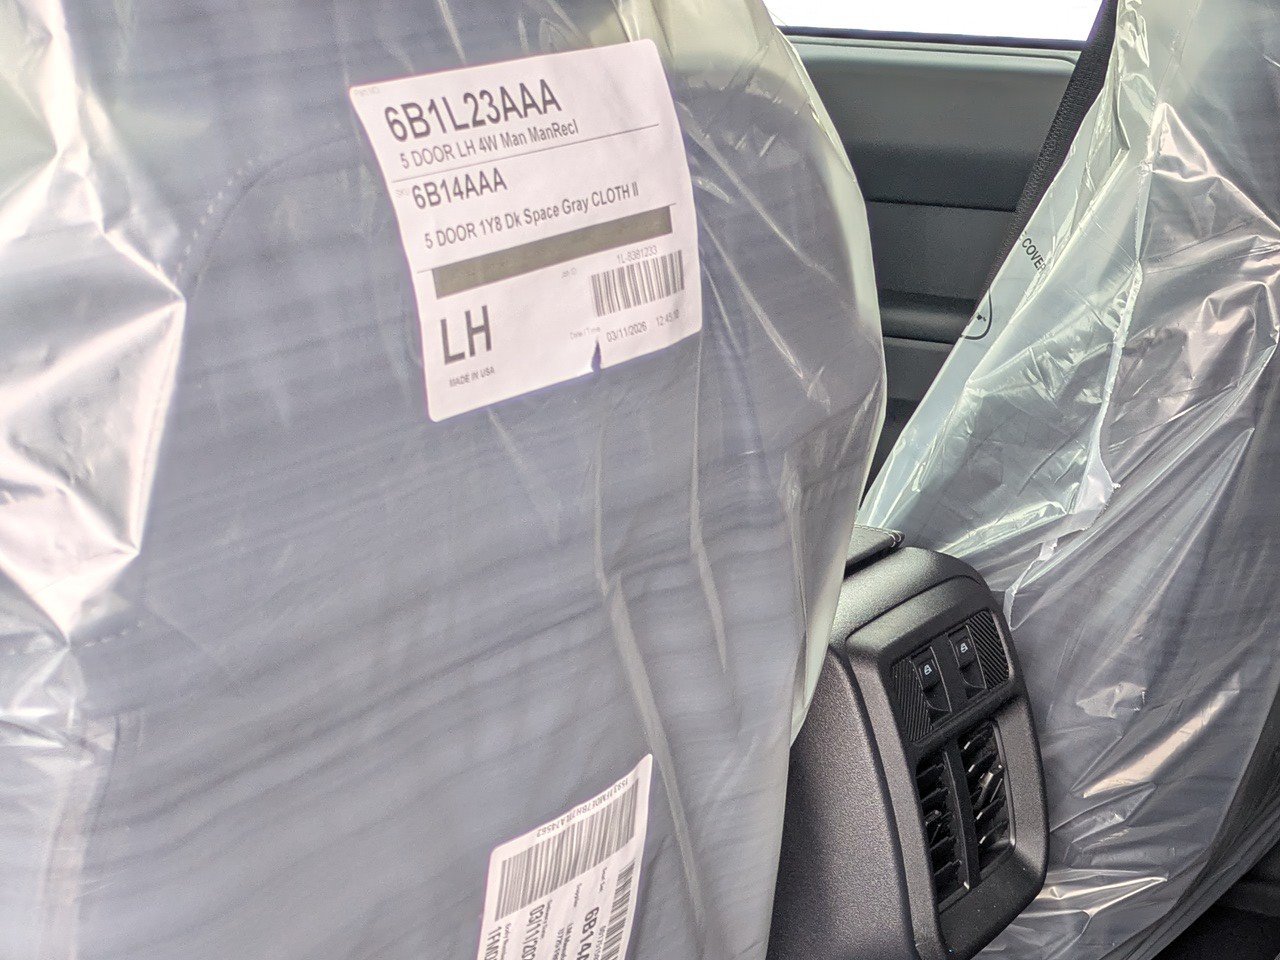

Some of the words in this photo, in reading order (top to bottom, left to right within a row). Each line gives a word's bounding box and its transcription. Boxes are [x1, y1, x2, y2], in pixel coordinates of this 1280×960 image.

[384, 78, 562, 143] 6B1L23AAA
[401, 153, 409, 170] 5
[411, 144, 455, 168] DOOR
[457, 139, 476, 158] LH
[479, 136, 499, 154] 4W
[500, 132, 527, 149] Man
[411, 168, 508, 210] 6B14AAA
[424, 233, 433, 249] 5
[436, 225, 478, 247] DOOR
[479, 216, 502, 236] 1Y8
[504, 211, 522, 230] Dk
[524, 205, 560, 229] Space
[561, 196, 589, 216] Gray
[591, 183, 631, 208] CLOTH
[1021, 238, 1047, 272] COVER
[440, 305, 492, 365] LH
[606, 321, 648, 343] 03/11/2026
[480, 366, 496, 378] USA
